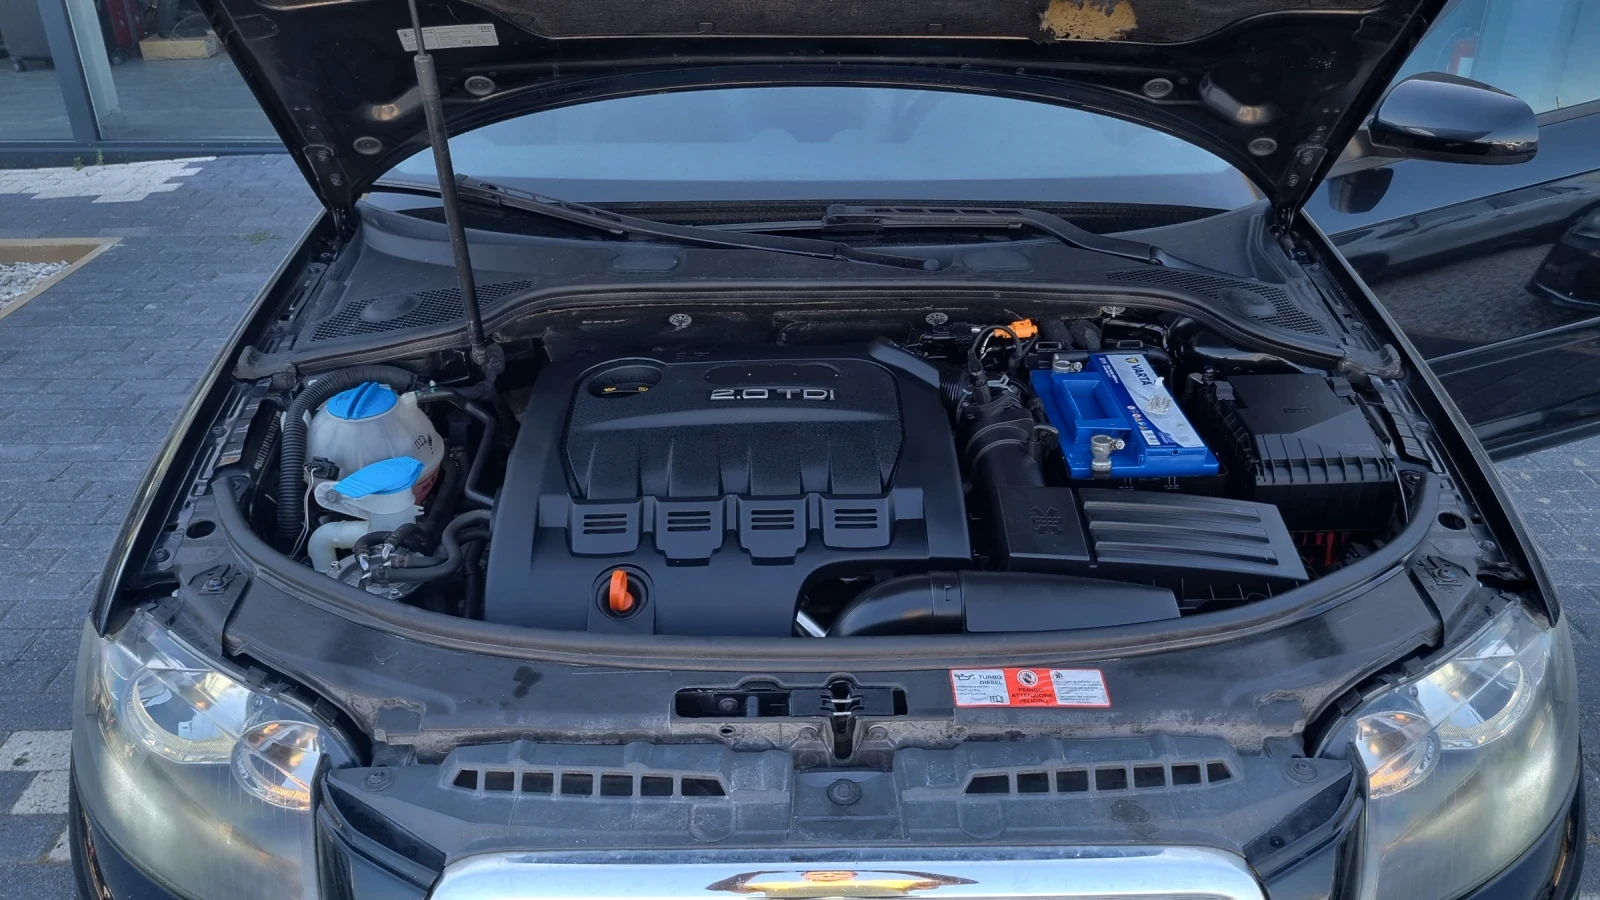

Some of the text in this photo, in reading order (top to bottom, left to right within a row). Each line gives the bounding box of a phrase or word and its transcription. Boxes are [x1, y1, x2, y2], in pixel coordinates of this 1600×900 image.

[1131, 363, 1153, 386] VARTA
[710, 388, 836, 401] 2.0 TDI
